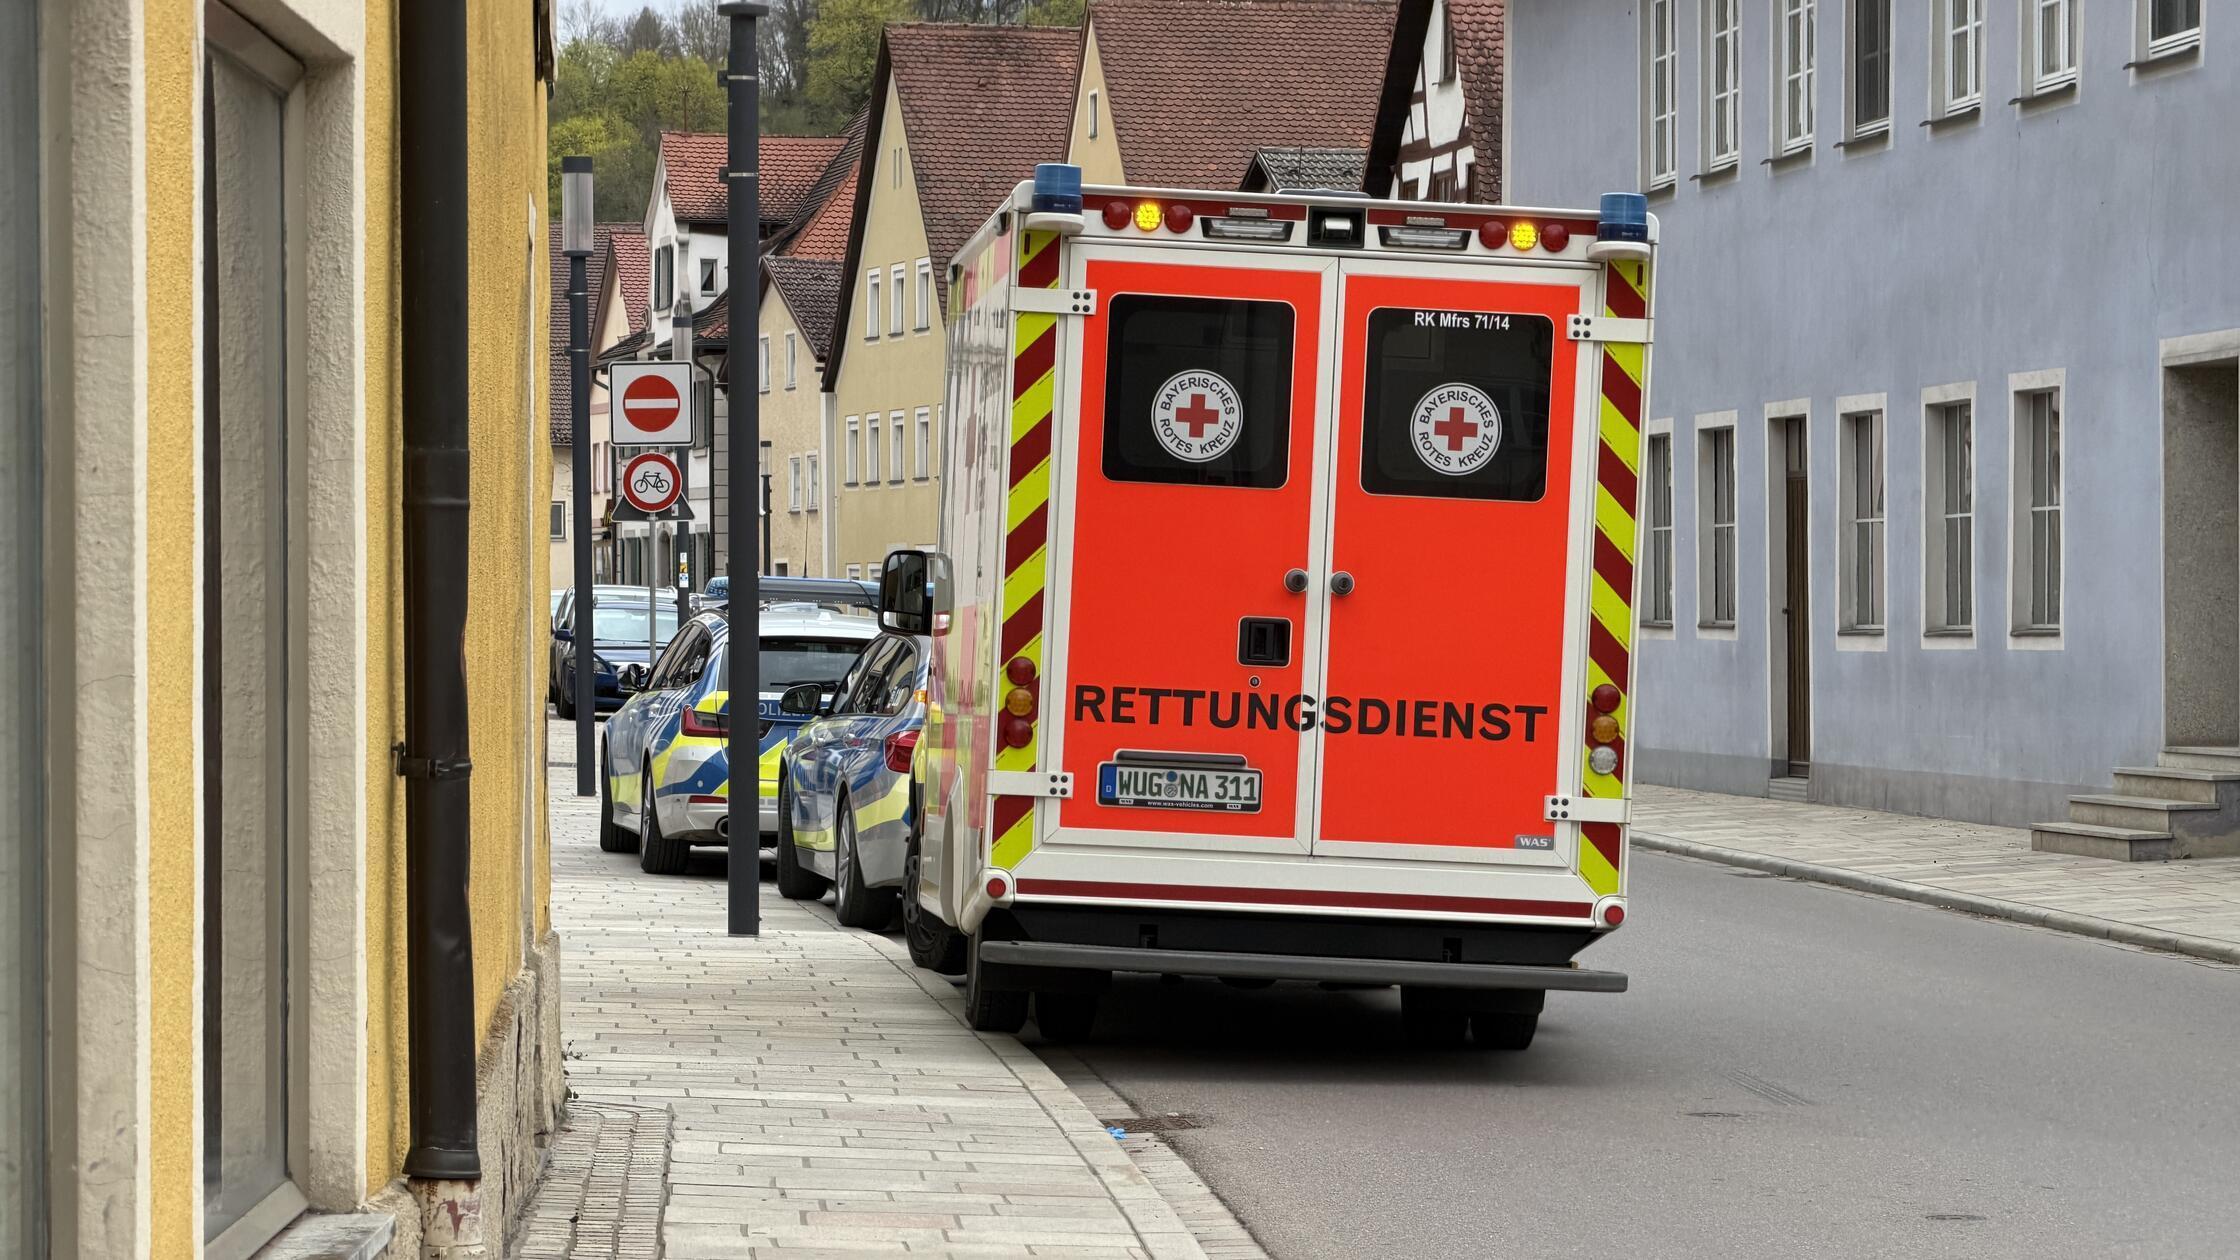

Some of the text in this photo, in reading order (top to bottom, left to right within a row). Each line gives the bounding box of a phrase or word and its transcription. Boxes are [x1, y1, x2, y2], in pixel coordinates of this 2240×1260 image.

[1414, 311, 1510, 331] RK Mfrs 71/14
[1160, 377, 1235, 415] BAYERISCHES
[1419, 390, 1494, 429] BAYERISCHES
[1160, 418, 1235, 454] ROTES KREUZ
[1418, 431, 1494, 467] ROTES KREUZ
[1074, 684, 1548, 742] RETTUNGSDIENST
[1118, 770, 1163, 797] WUG
[1179, 773, 1209, 800] NA
[1214, 775, 1257, 801] 311
[1520, 837, 1548, 847] WAS
